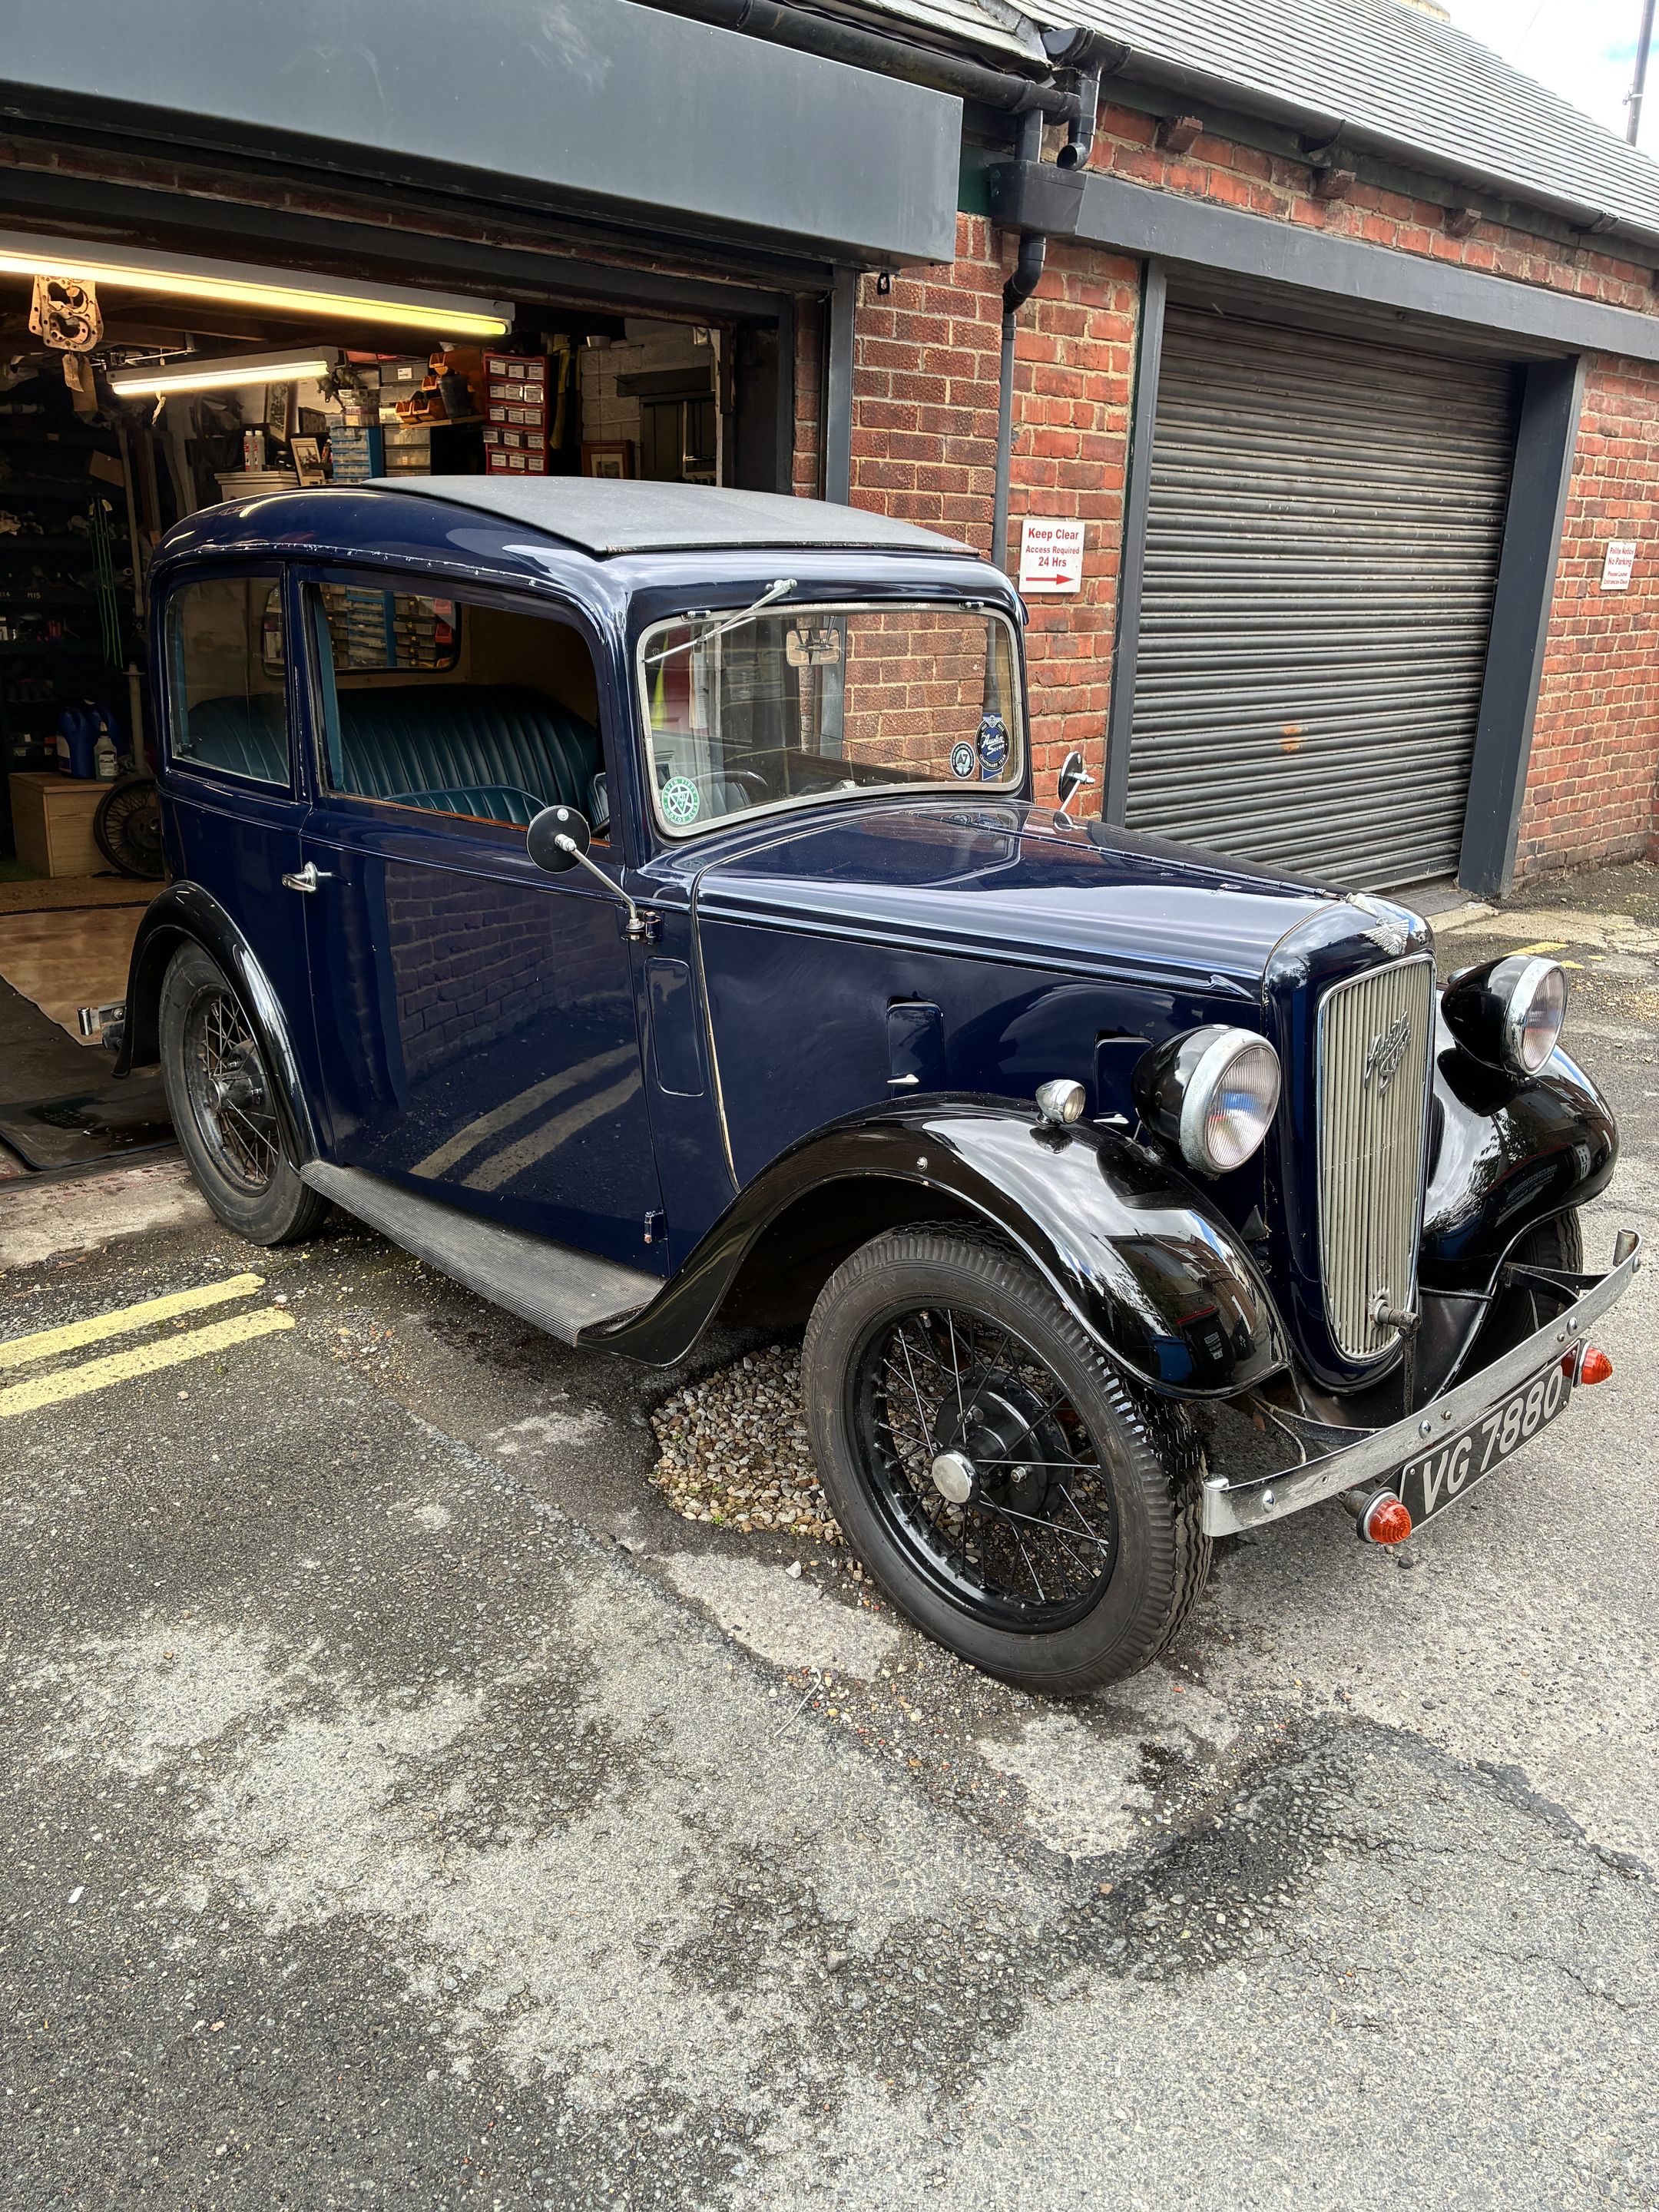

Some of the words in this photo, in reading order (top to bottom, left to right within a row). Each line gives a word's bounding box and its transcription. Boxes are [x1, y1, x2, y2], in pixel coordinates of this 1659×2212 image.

[1028, 528, 1053, 541] Keep
[1056, 529, 1080, 540] Clear
[1025, 545, 1051, 554] Access
[1052, 545, 1080, 555] Required
[1038, 556, 1049, 567] 24
[1052, 556, 1067, 567] Hrs
[1608, 557, 1614, 565] No
[1615, 557, 1632, 567] Parking
[981, 733, 1004, 749] Austin
[986, 743, 1005, 756] Seven
[957, 753, 969, 764] A7
[1422, 1436, 1472, 1515] VG
[1480, 1365, 1563, 1472] 7880
